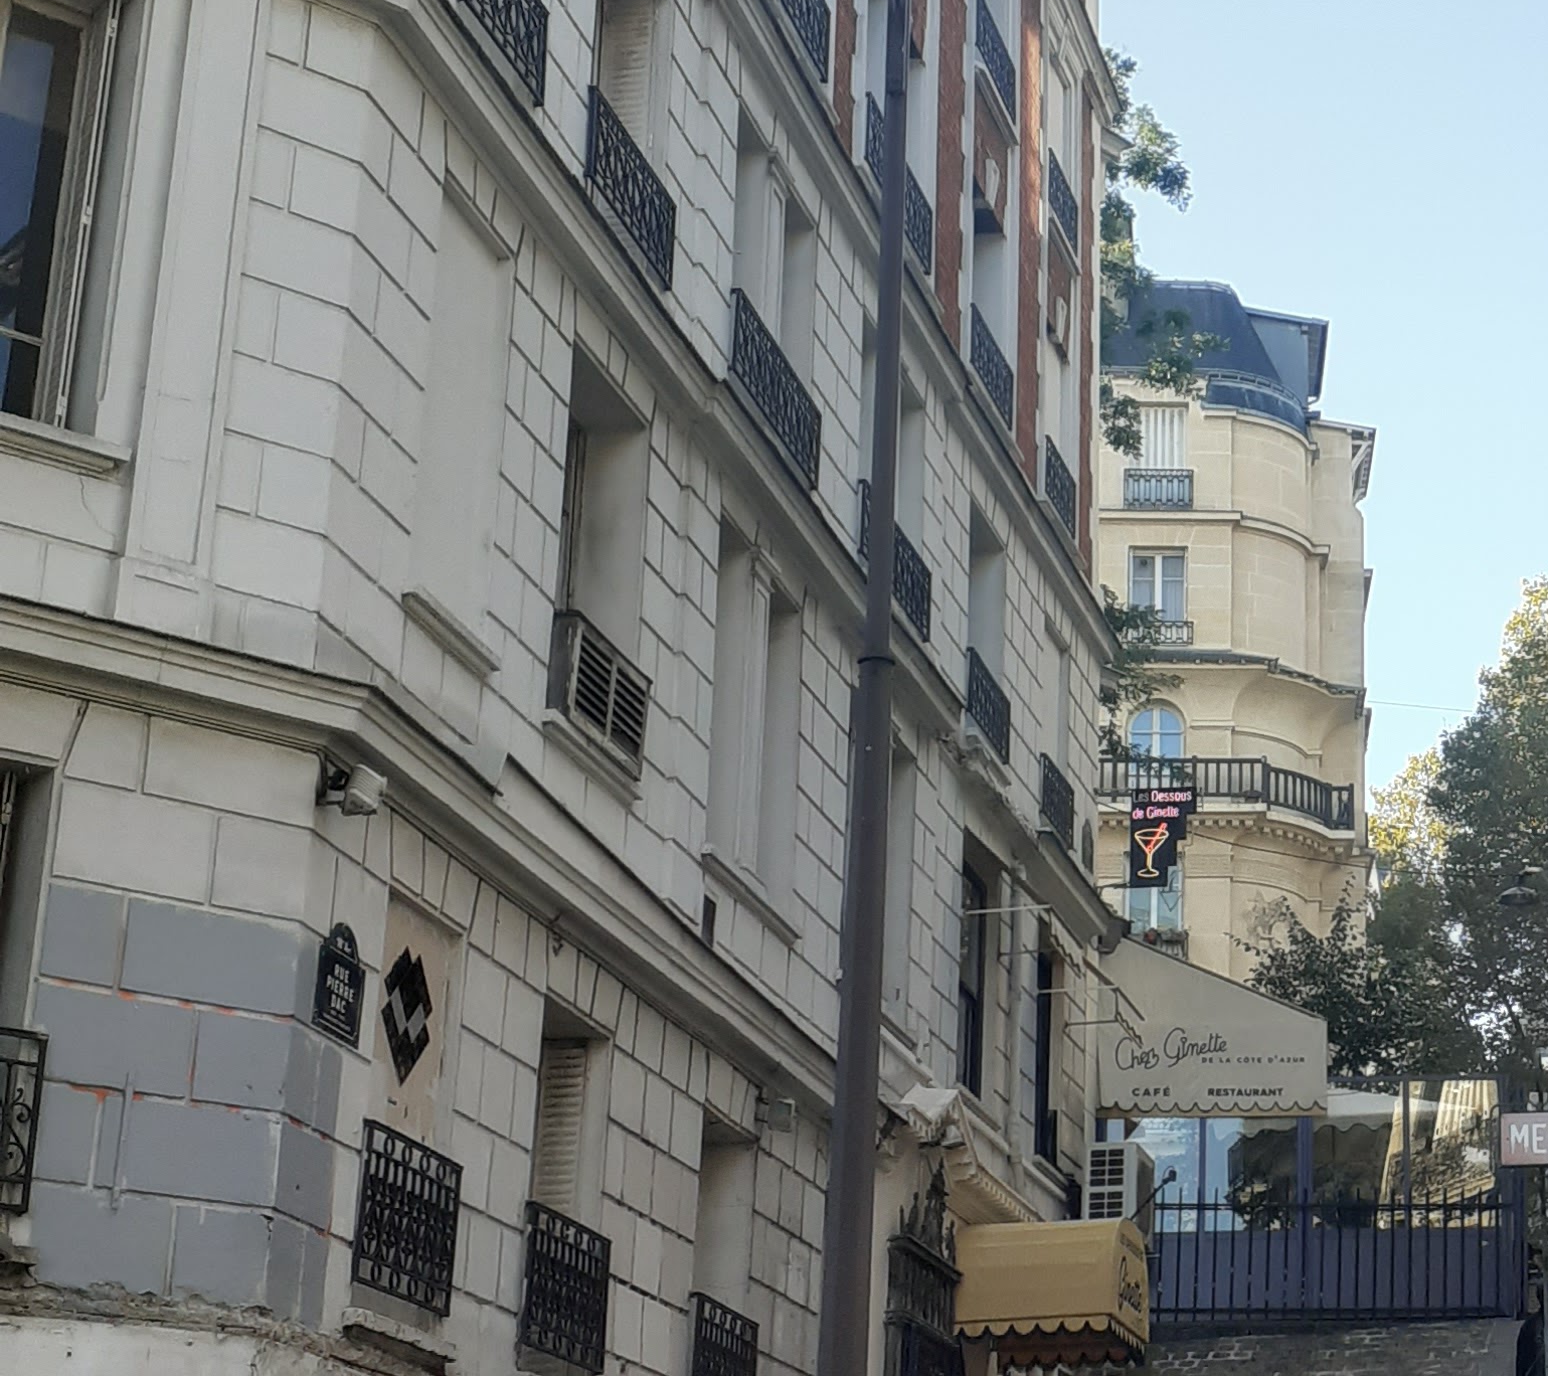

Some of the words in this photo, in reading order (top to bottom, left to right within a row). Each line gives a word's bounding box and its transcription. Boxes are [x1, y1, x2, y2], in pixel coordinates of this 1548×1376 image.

[1133, 791, 1149, 802] Les
[1151, 790, 1192, 802] Dessous
[1132, 808, 1144, 819] de
[334, 964, 350, 984] RUE
[326, 974, 354, 1003] PIERRE
[1115, 1037, 1160, 1070] Chez
[1163, 1027, 1227, 1068] Ginette
[1132, 1086, 1171, 1097] CAFÉ
[1207, 1088, 1284, 1097] RESTAURANT
